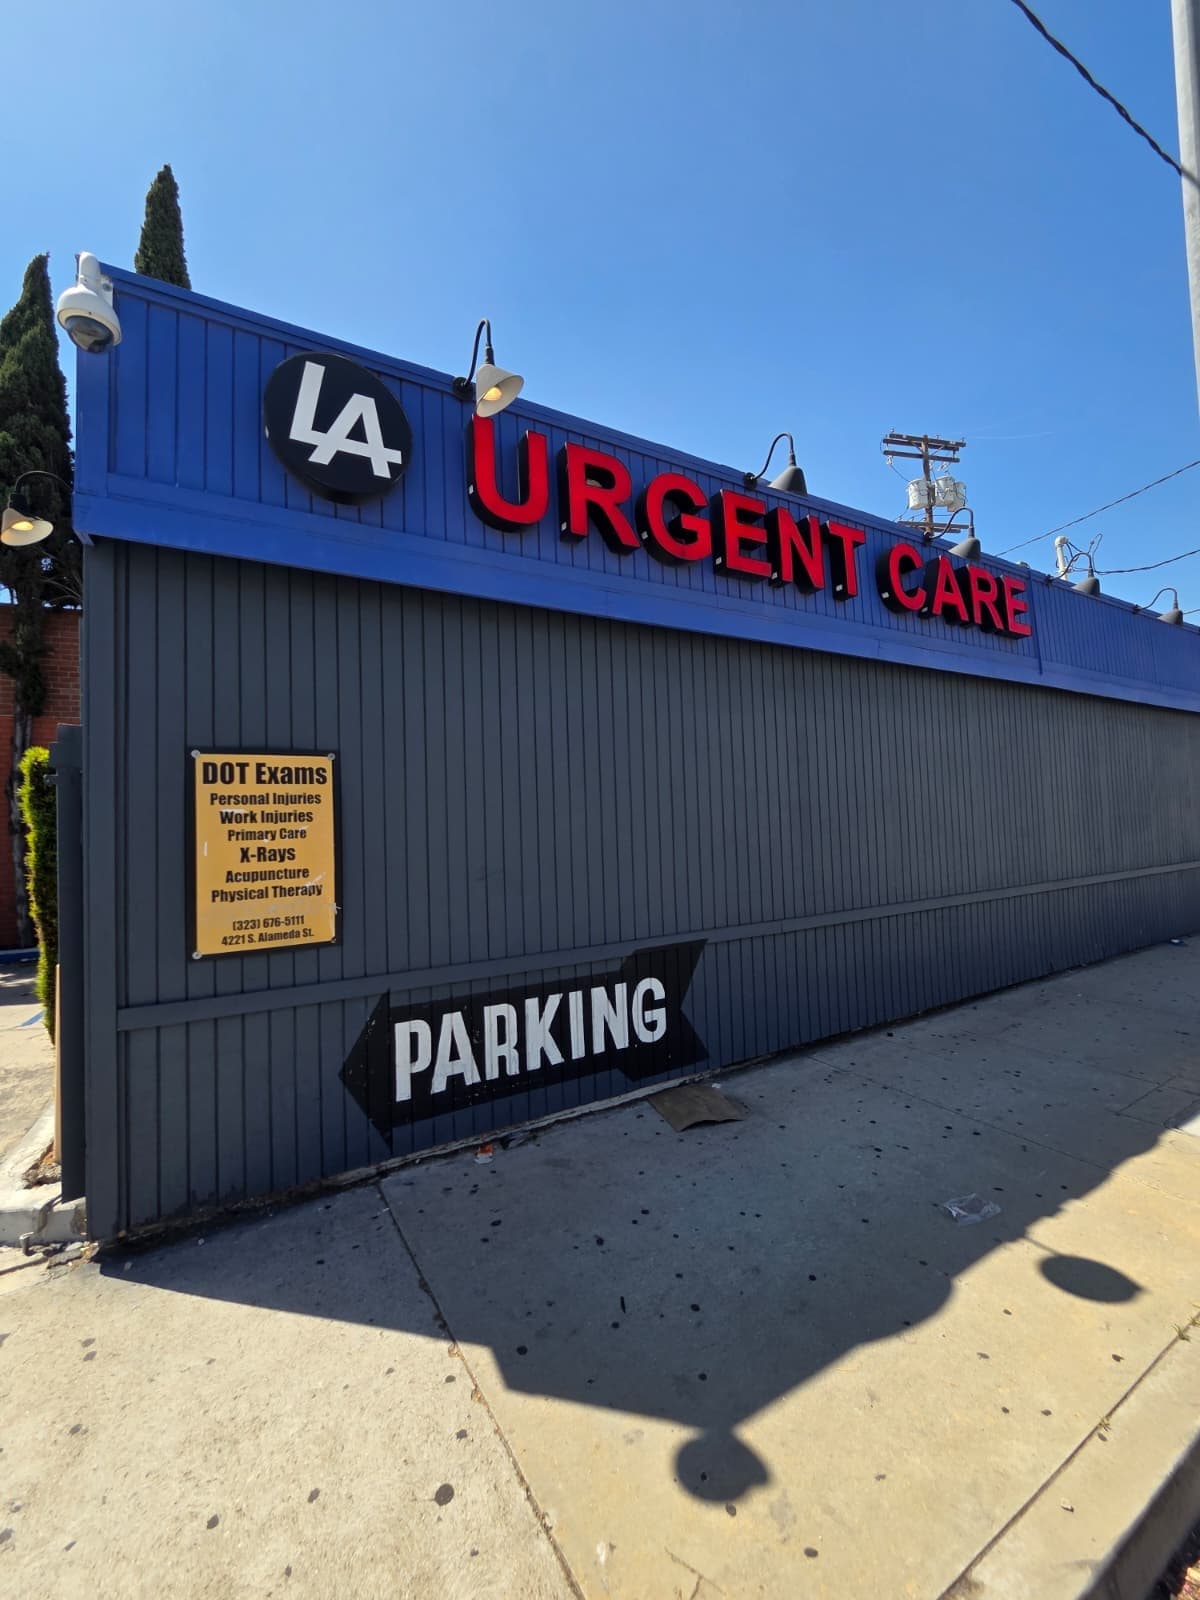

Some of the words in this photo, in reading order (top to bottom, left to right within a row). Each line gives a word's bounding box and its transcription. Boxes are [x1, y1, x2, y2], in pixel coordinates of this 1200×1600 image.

[288, 360, 403, 478] LA
[467, 412, 866, 601] URGENT
[877, 542, 1033, 640] CARE
[202, 762, 249, 785] DOT
[255, 762, 328, 785] Exams
[210, 792, 270, 806] Personal
[272, 793, 321, 806] Injuries
[219, 810, 258, 824] Work
[261, 810, 314, 825] Injuries
[227, 829, 276, 841] Primary
[279, 827, 307, 839] Care
[240, 846, 296, 863] X-Rays
[225, 867, 310, 883] Acupuncture
[211, 886, 269, 903] Physical
[271, 883, 323, 898] Therapy
[232, 919, 261, 931] (323)
[263, 915, 305, 928] 676-5111
[221, 935, 245, 946] 4221
[247, 933, 256, 943] S.
[258, 930, 301, 943] Alameda
[302, 927, 315, 938] St.
[394, 977, 668, 1103] PARKING
